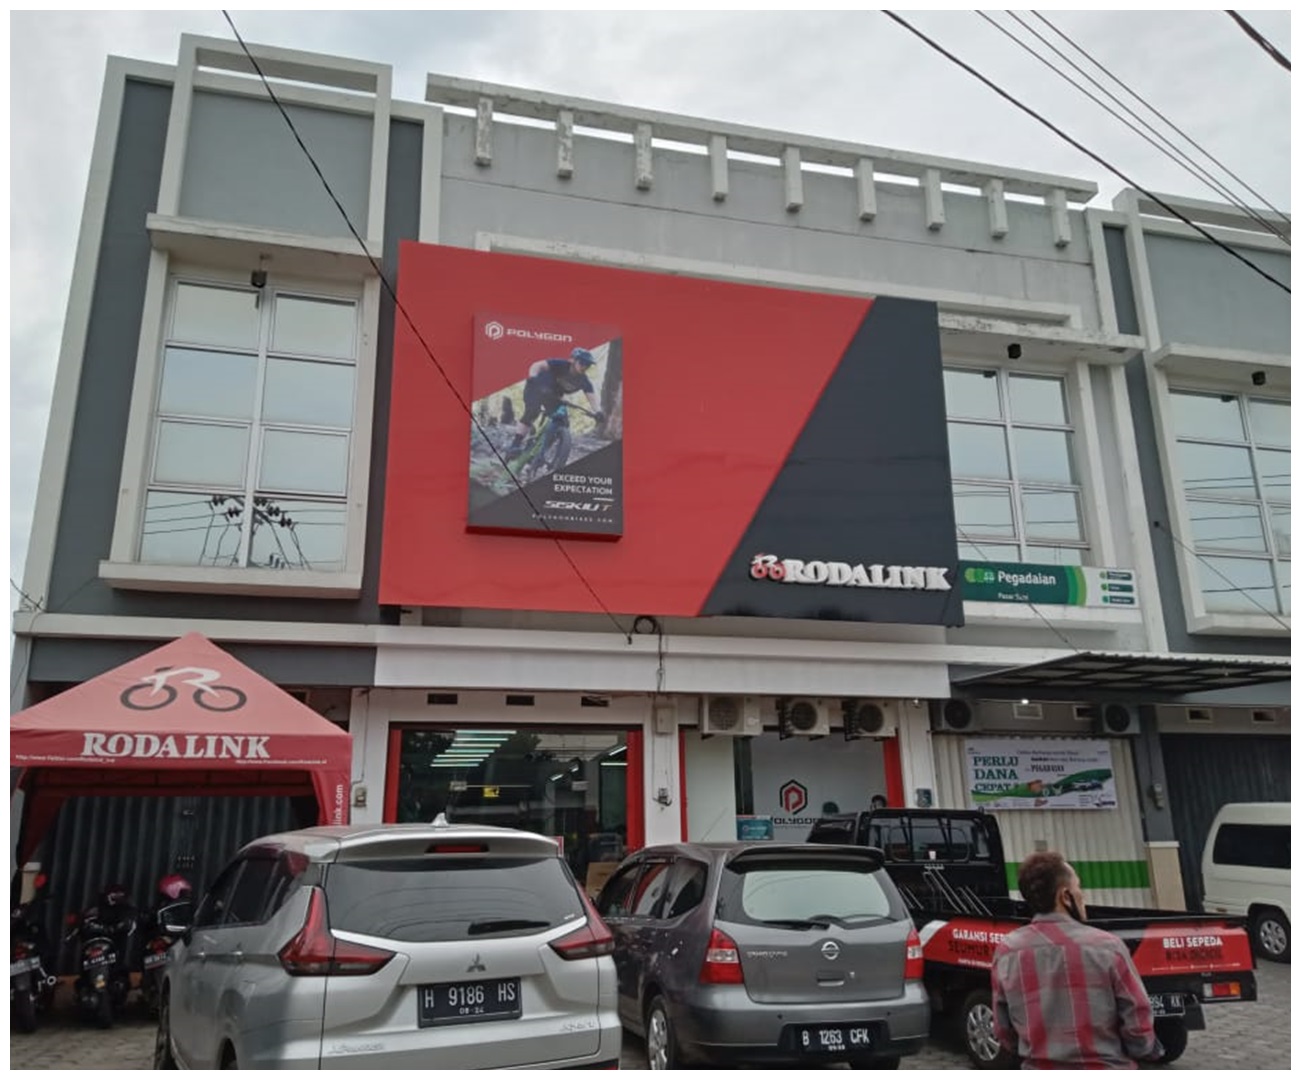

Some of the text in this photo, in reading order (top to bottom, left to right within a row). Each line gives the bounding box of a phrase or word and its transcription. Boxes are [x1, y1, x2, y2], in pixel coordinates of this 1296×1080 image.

[506, 328, 573, 343] POLYGON
[553, 473, 613, 485] EXCEED YOUR
[554, 483, 613, 495] EXPECTATION
[783, 559, 951, 590] RODALINK
[997, 570, 1057, 587] Pegadaian
[80, 732, 271, 758] RODALINK
[973, 755, 1019, 767] PERLU
[973, 768, 1019, 780] DANA
[974, 783, 1011, 792] CEPAT
[770, 816, 819, 825] OLYGO
[953, 928, 988, 942] GARANSI
[1162, 935, 1223, 949] BELI SEPEDA
[424, 983, 516, 1008] H 9186 HS
[801, 1028, 870, 1046] B 1263 CFK
